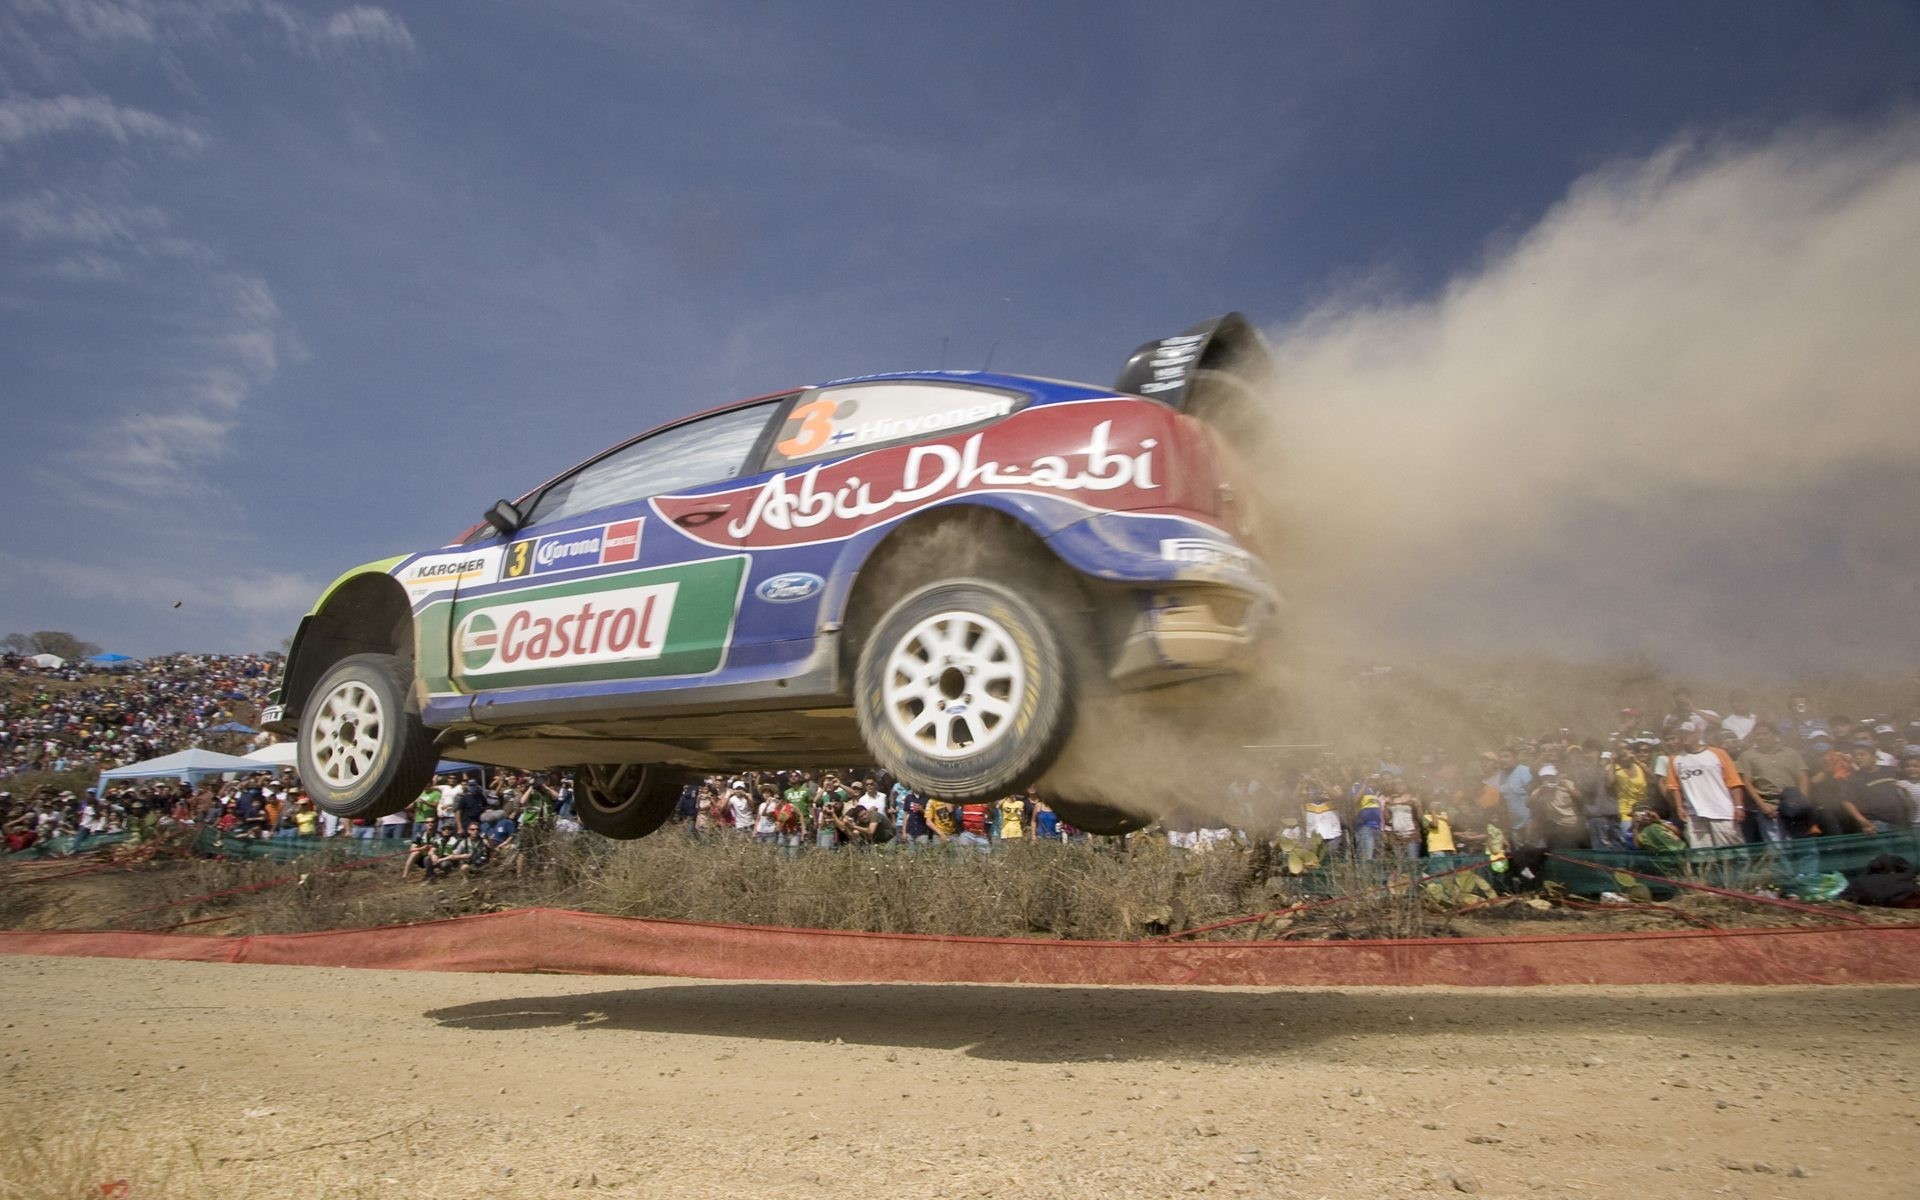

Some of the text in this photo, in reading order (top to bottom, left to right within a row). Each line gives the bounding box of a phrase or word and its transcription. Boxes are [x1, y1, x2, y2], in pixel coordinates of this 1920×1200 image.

[777, 399, 837, 456] 3
[856, 397, 1014, 441] Hirvonen
[899, 420, 1160, 502] Dhabi
[509, 541, 529, 577] 3
[537, 537, 601, 566] Corona
[766, 577, 814, 598] Ford
[501, 594, 658, 663] Castrol
